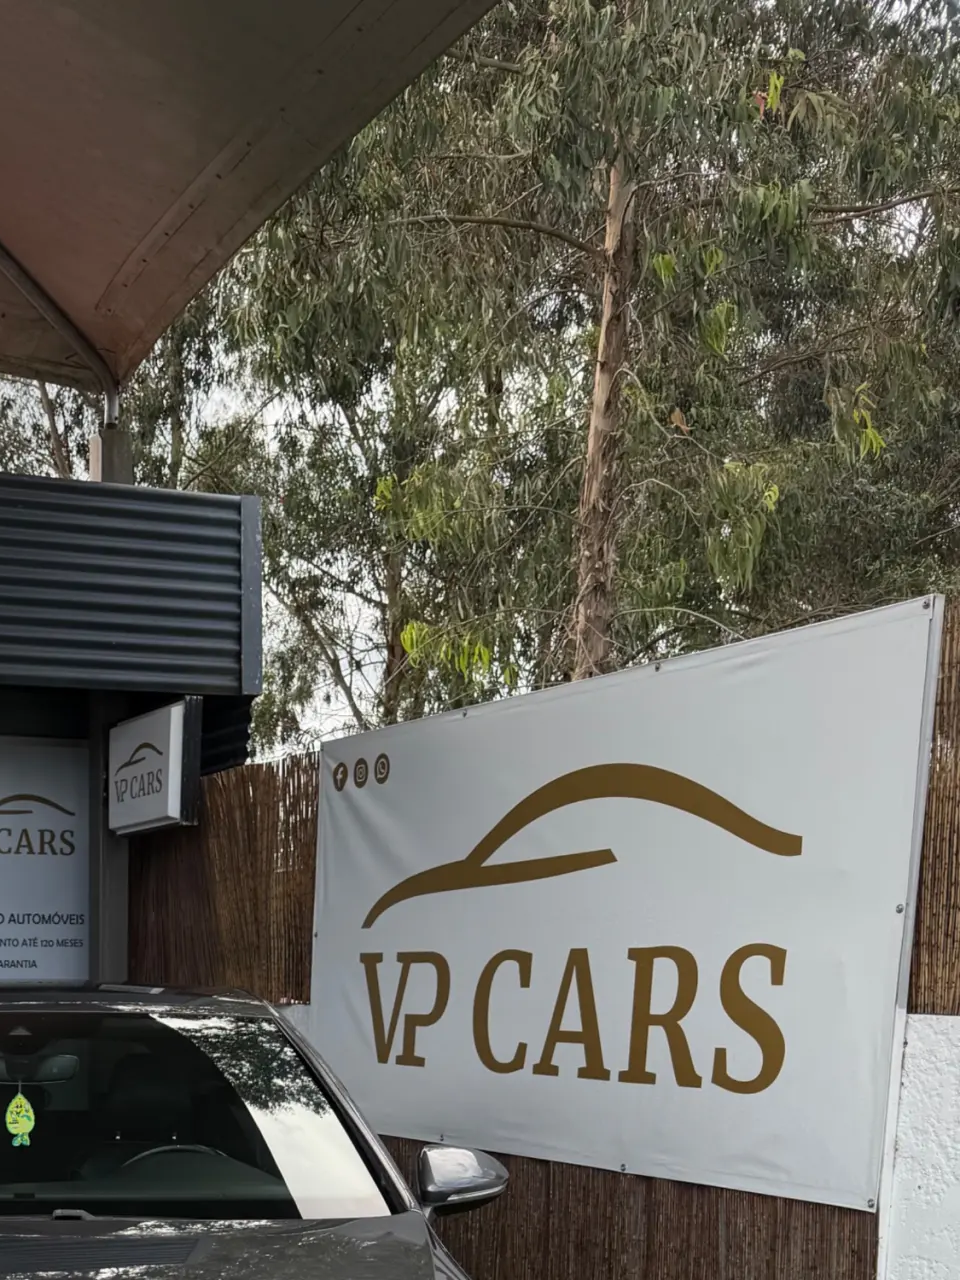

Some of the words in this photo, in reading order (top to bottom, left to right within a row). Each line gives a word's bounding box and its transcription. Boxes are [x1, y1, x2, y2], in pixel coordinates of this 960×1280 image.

[114, 778, 128, 803] VP
[130, 768, 163, 799] CARS
[7, 911, 85, 925] AUTOMÓVEIS
[21, 937, 38, 948] ATÉ
[56, 939, 84, 948] MESES
[359, 951, 451, 1067] VP
[472, 942, 788, 1094] CARS
